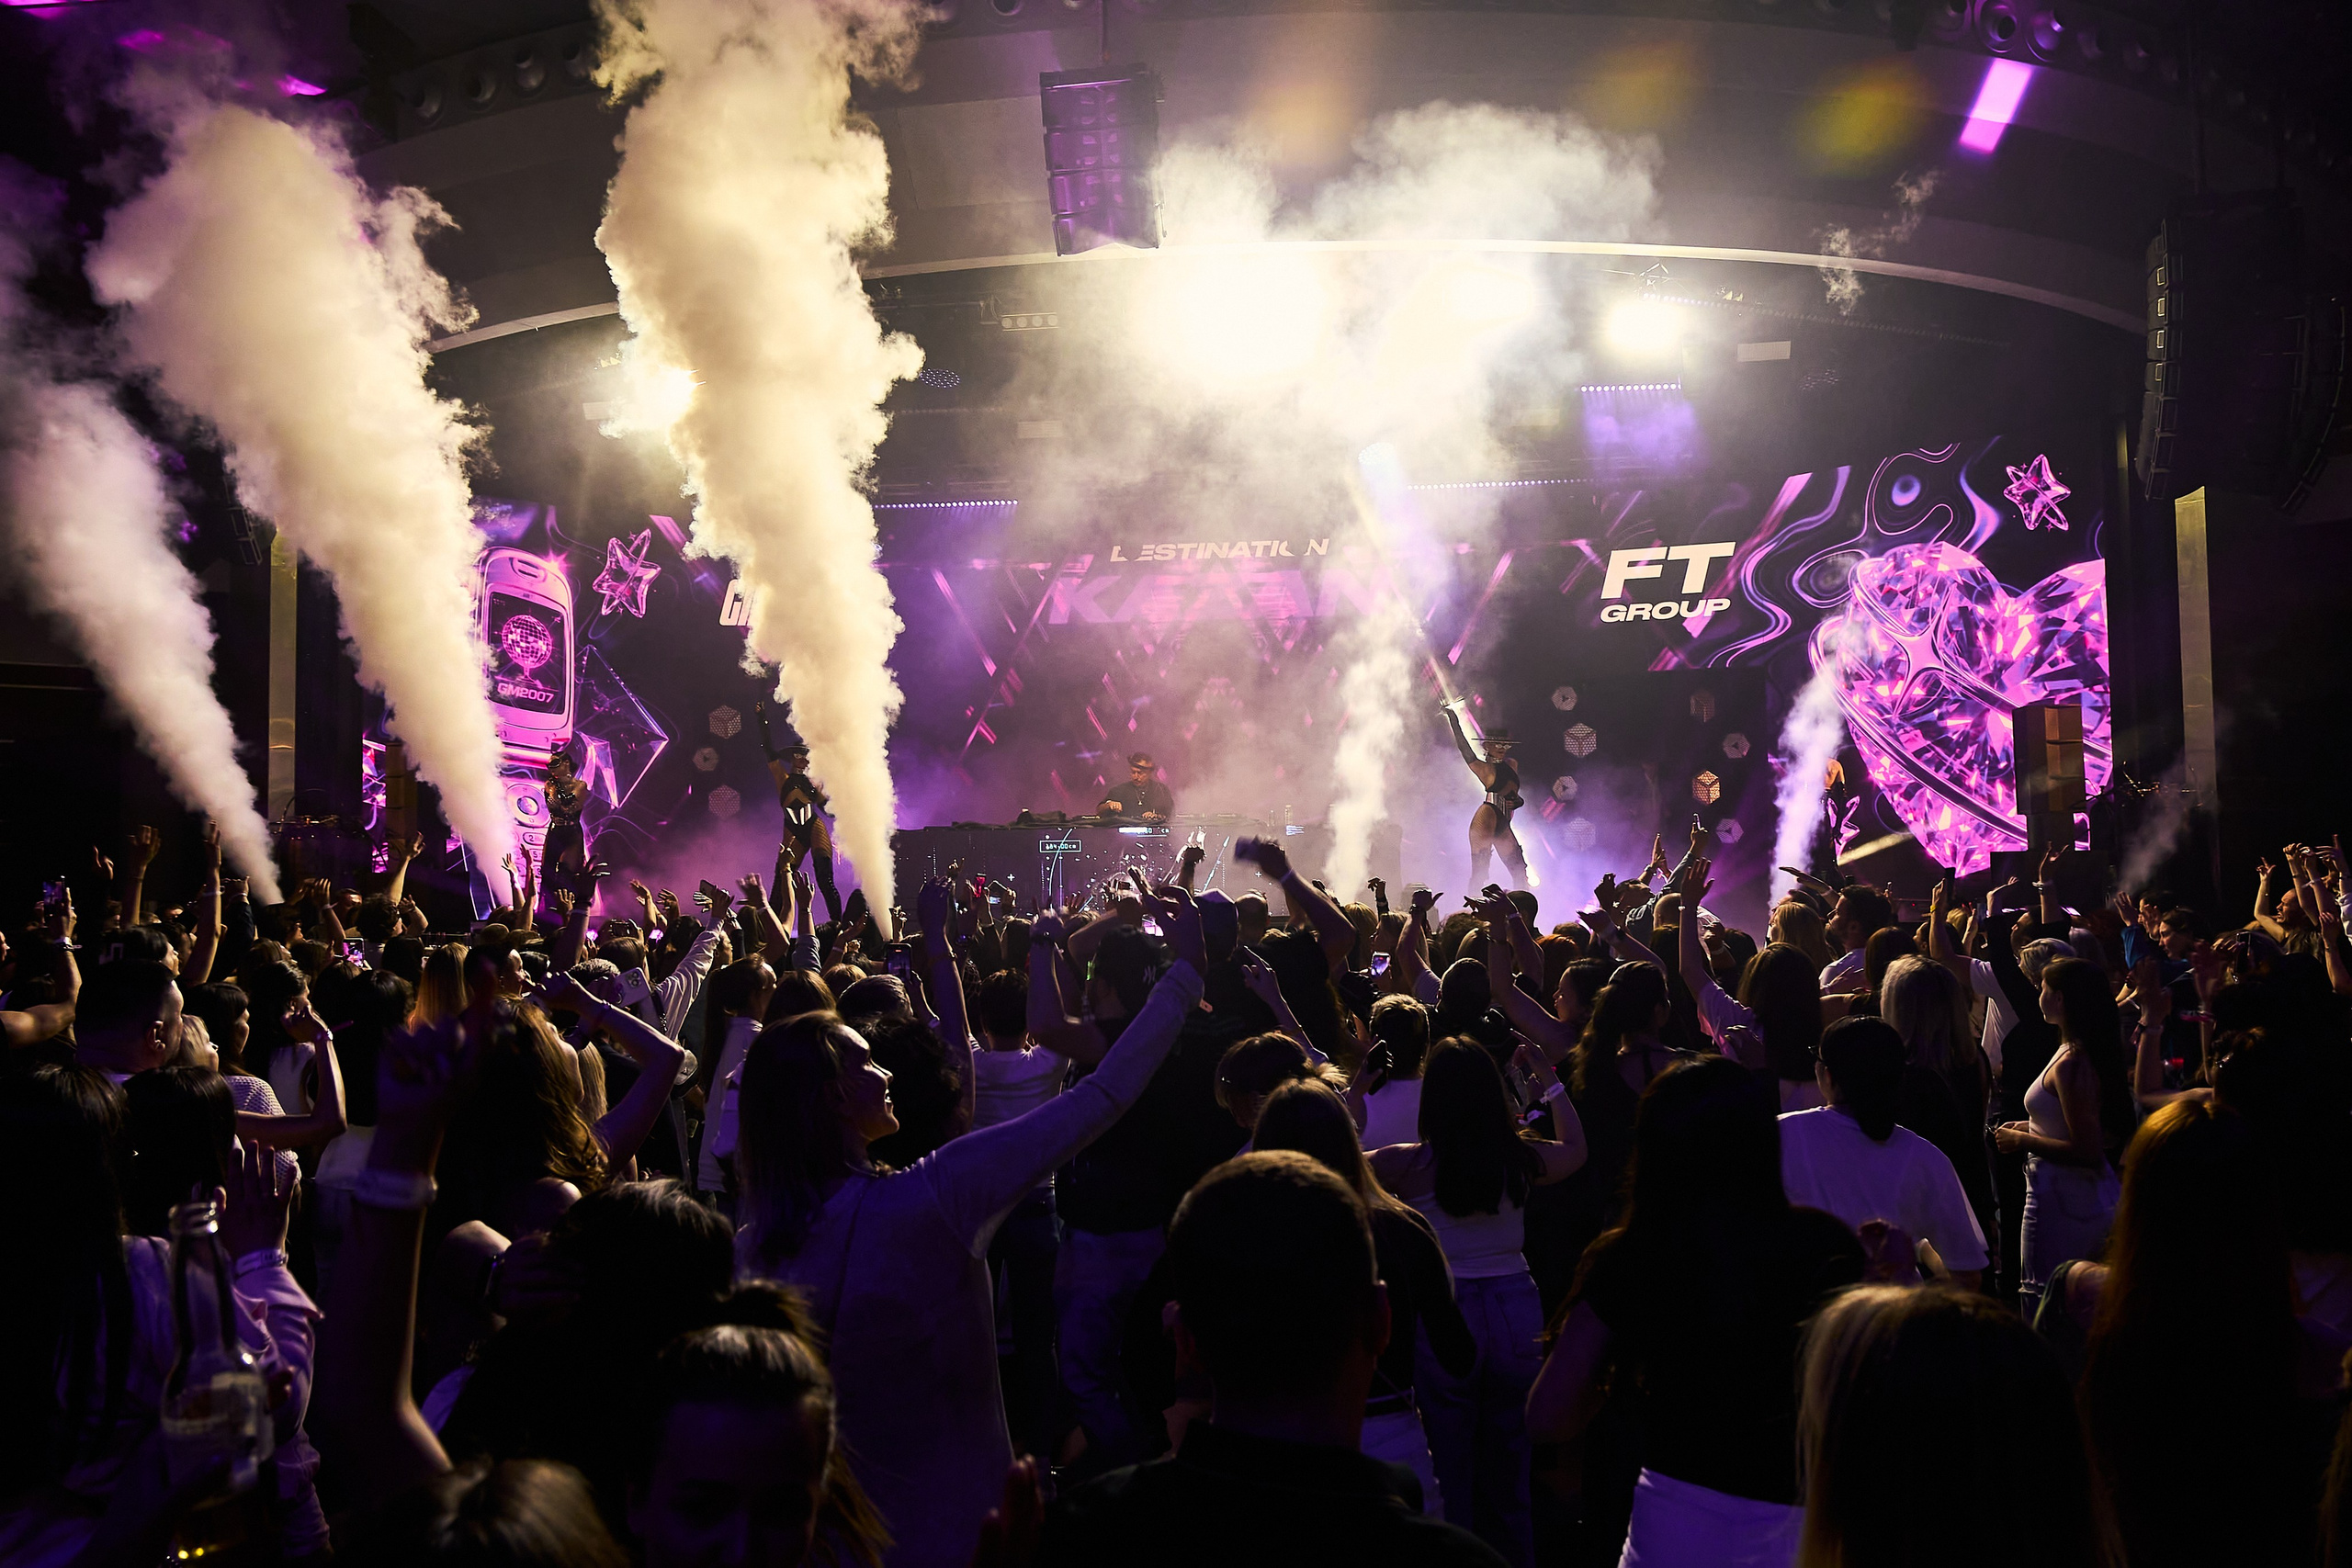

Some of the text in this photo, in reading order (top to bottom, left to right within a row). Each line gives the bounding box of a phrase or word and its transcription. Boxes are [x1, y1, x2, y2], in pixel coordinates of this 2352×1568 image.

[1600, 541, 1736, 599] FT
[1600, 598, 1731, 623] GROUP
[497, 682, 554, 704] GM2007
